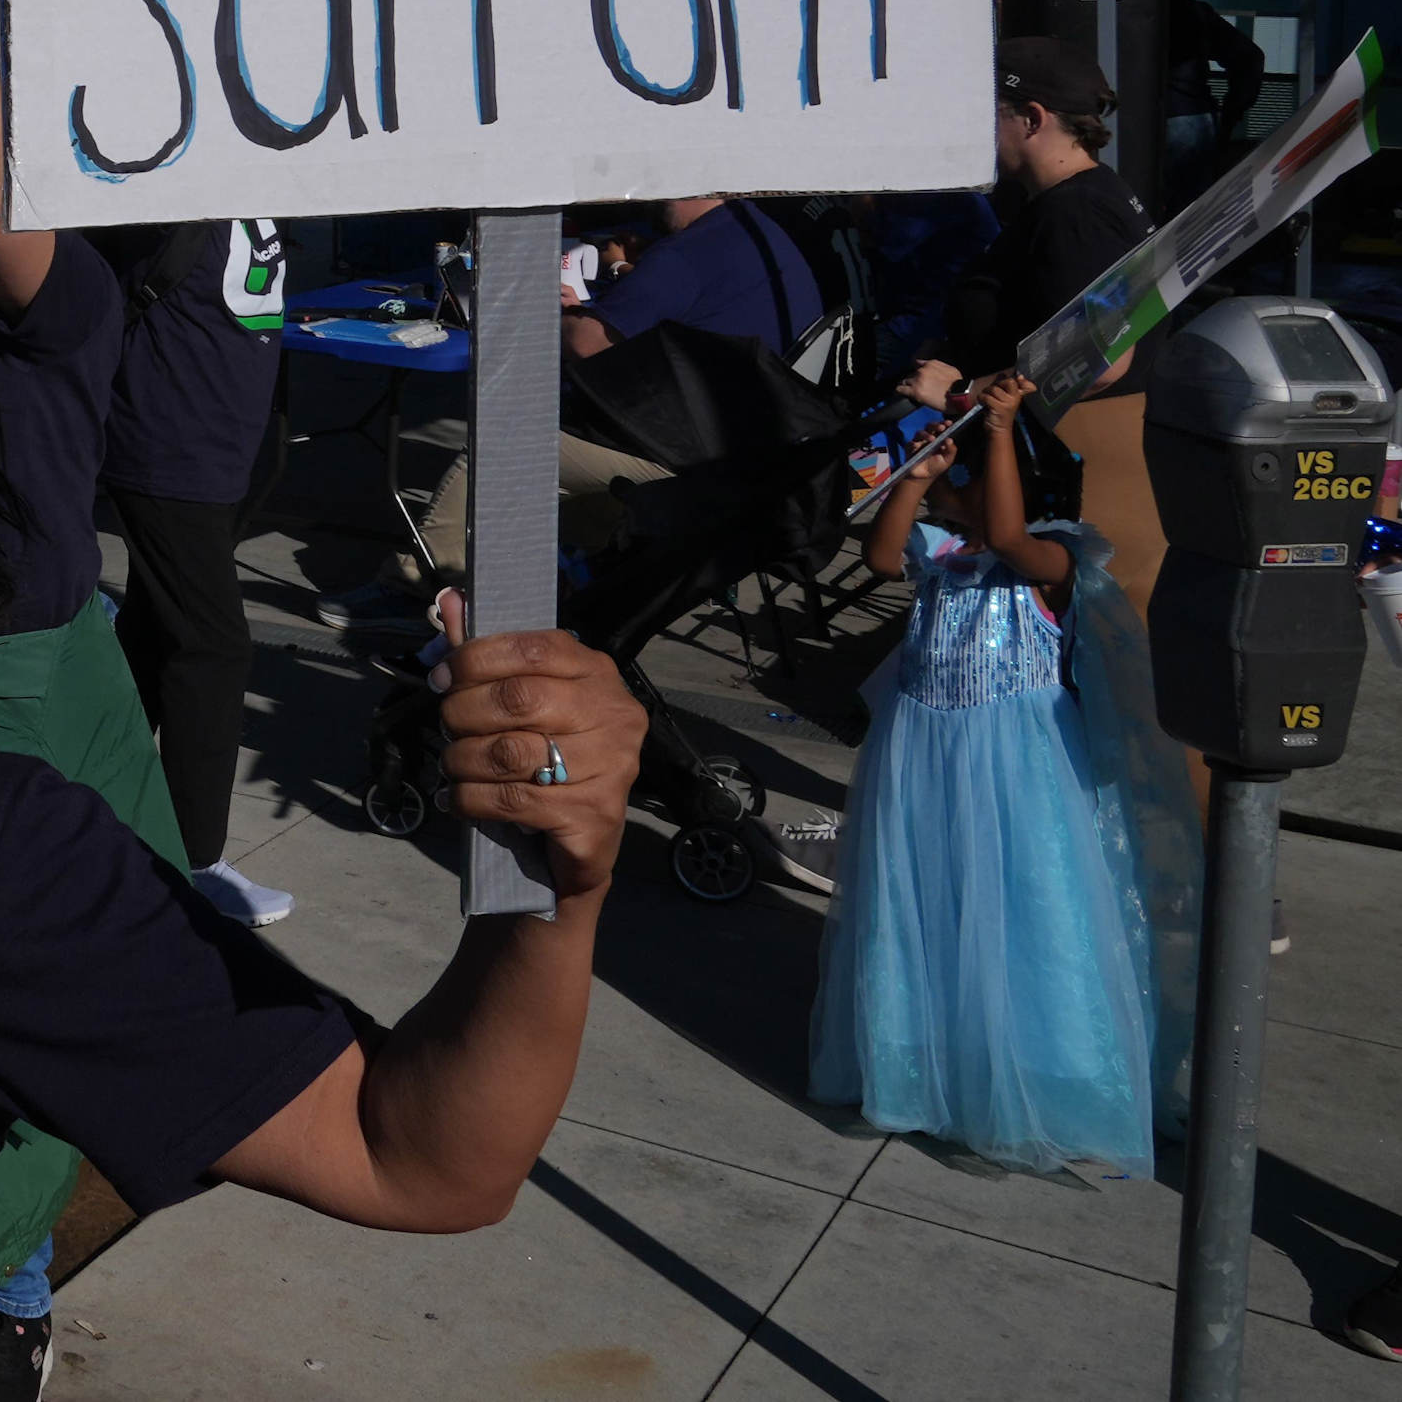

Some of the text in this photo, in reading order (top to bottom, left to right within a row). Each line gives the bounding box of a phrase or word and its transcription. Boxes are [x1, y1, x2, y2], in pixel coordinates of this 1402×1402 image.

[1297, 451, 1334, 475] VS
[1293, 477, 1372, 501] 266C
[1282, 705, 1321, 729] VS
